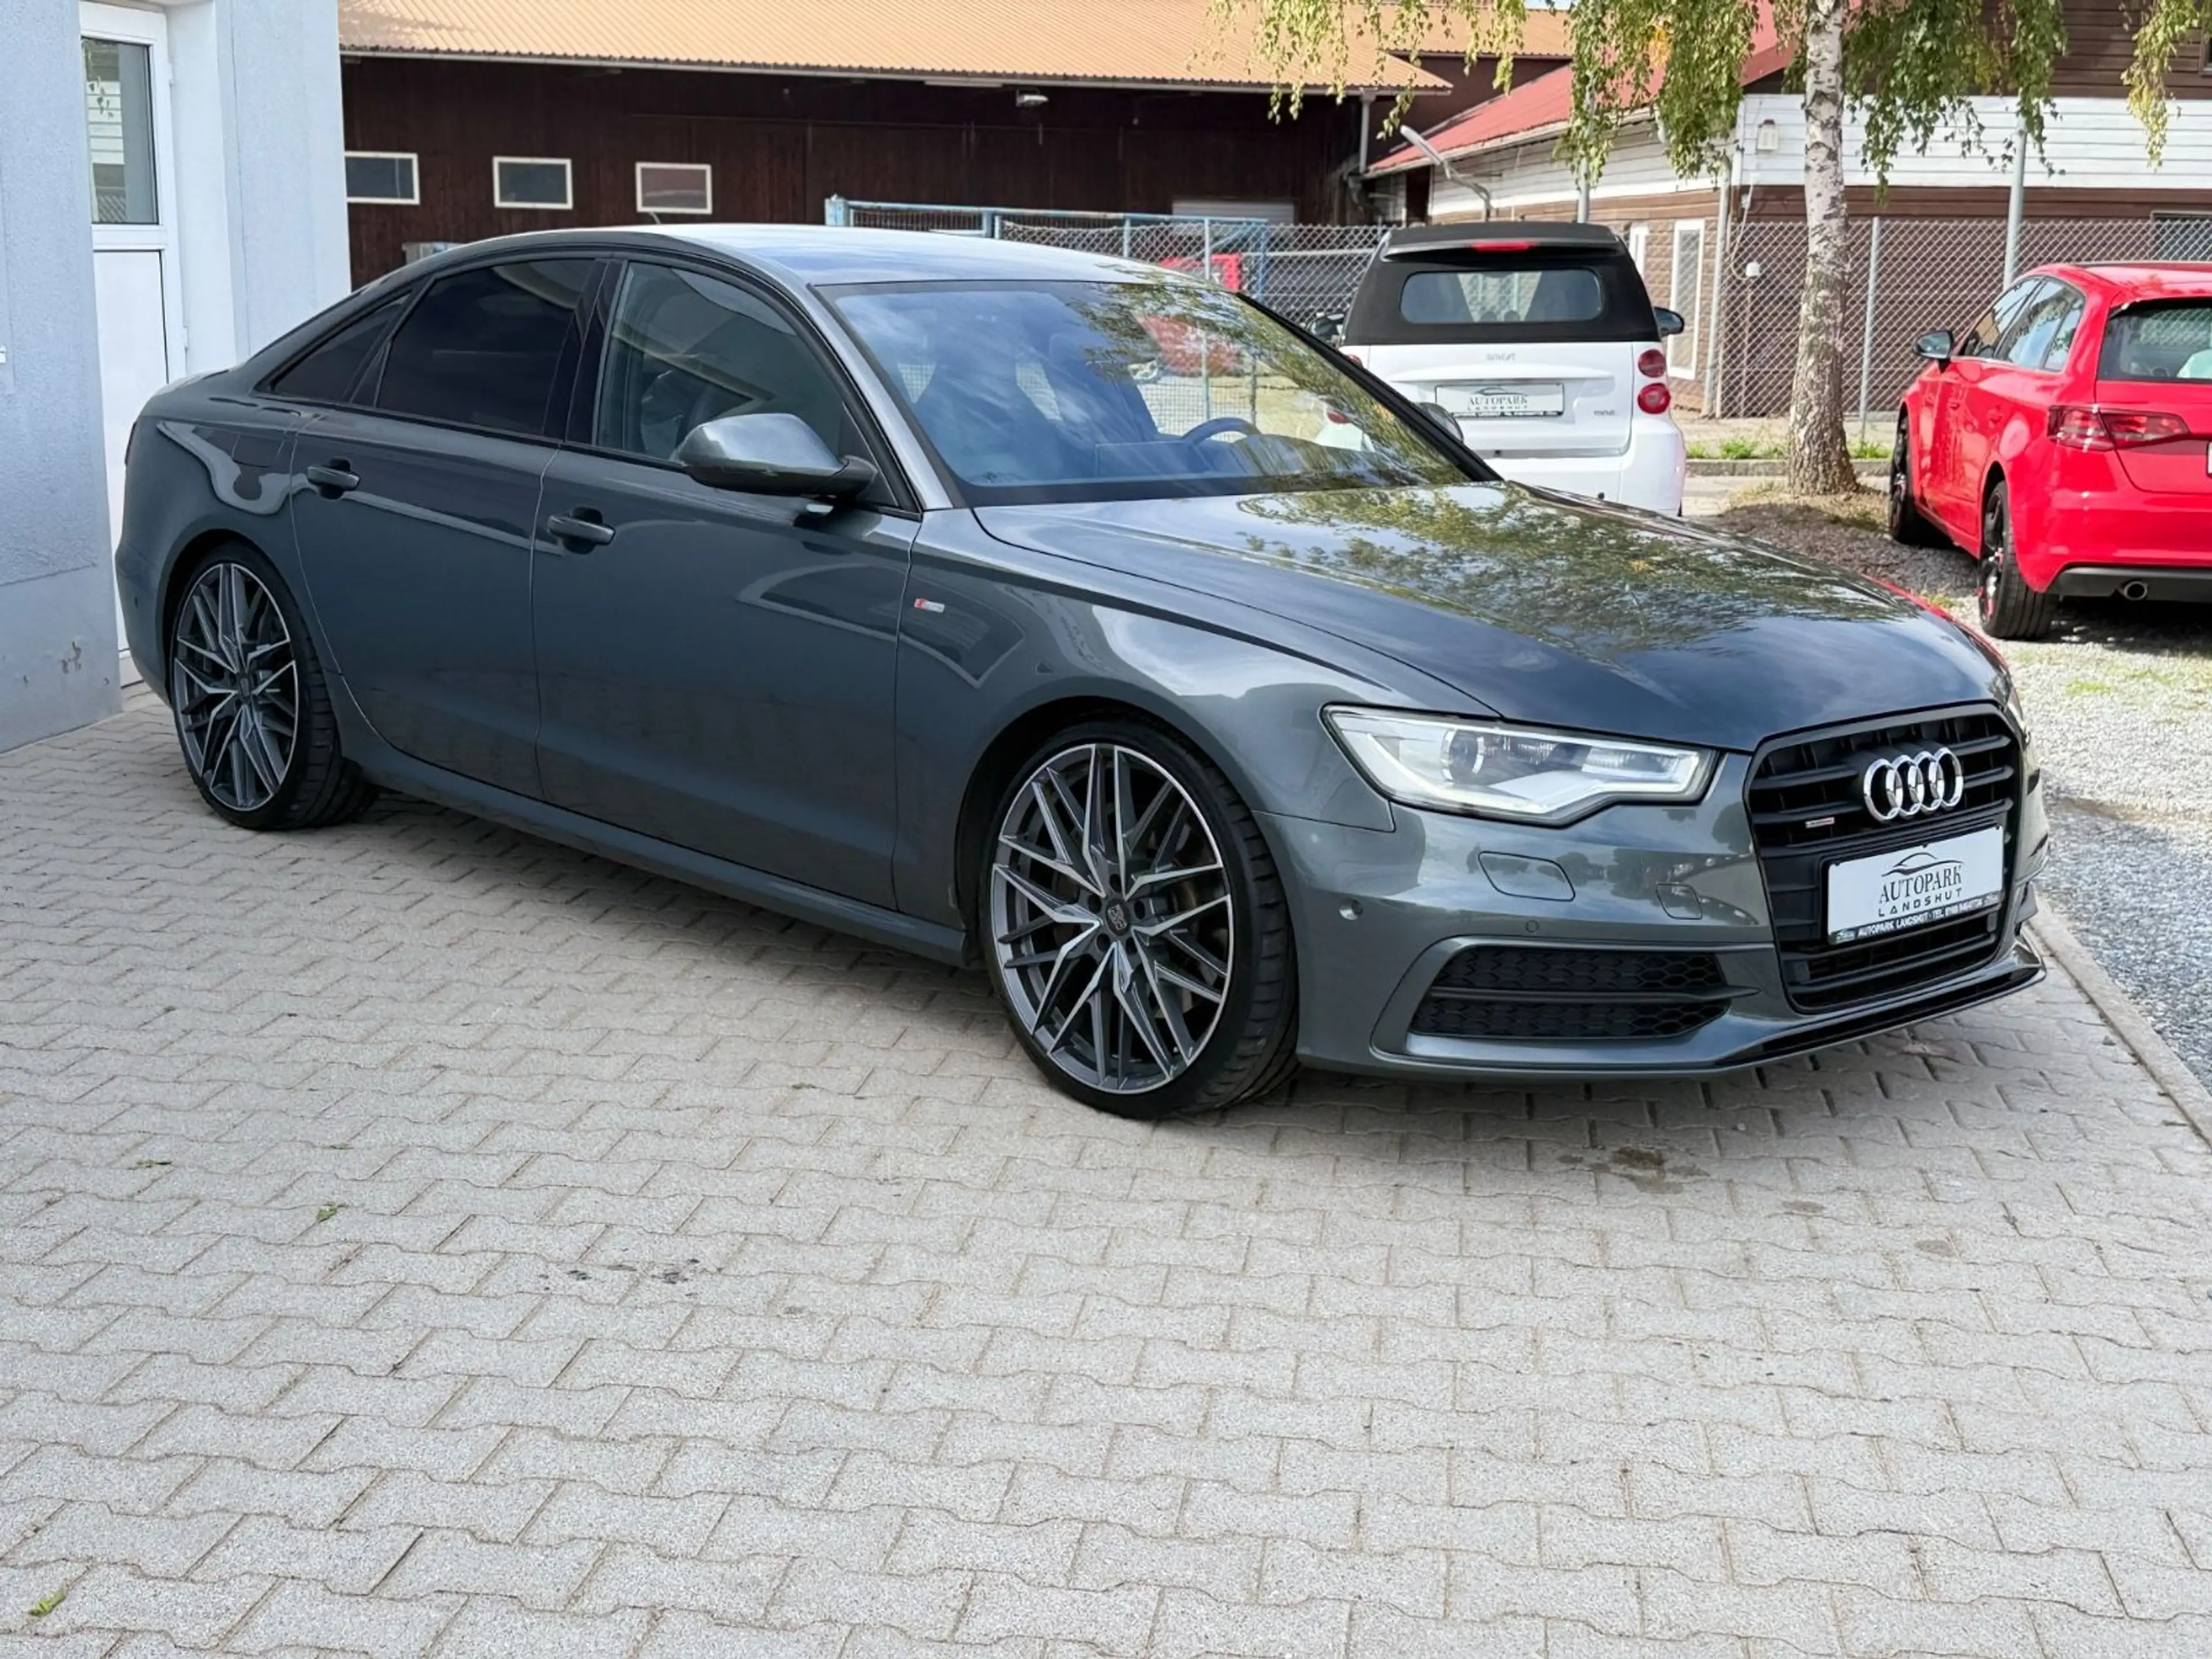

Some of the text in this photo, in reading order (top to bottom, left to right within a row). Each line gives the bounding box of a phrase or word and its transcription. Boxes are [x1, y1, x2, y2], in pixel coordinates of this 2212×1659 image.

[1468, 395, 1528, 404] AUTOPARK
[1878, 865, 1962, 904] AUTOPARK
[1878, 887, 1962, 918] LANDSHUT
